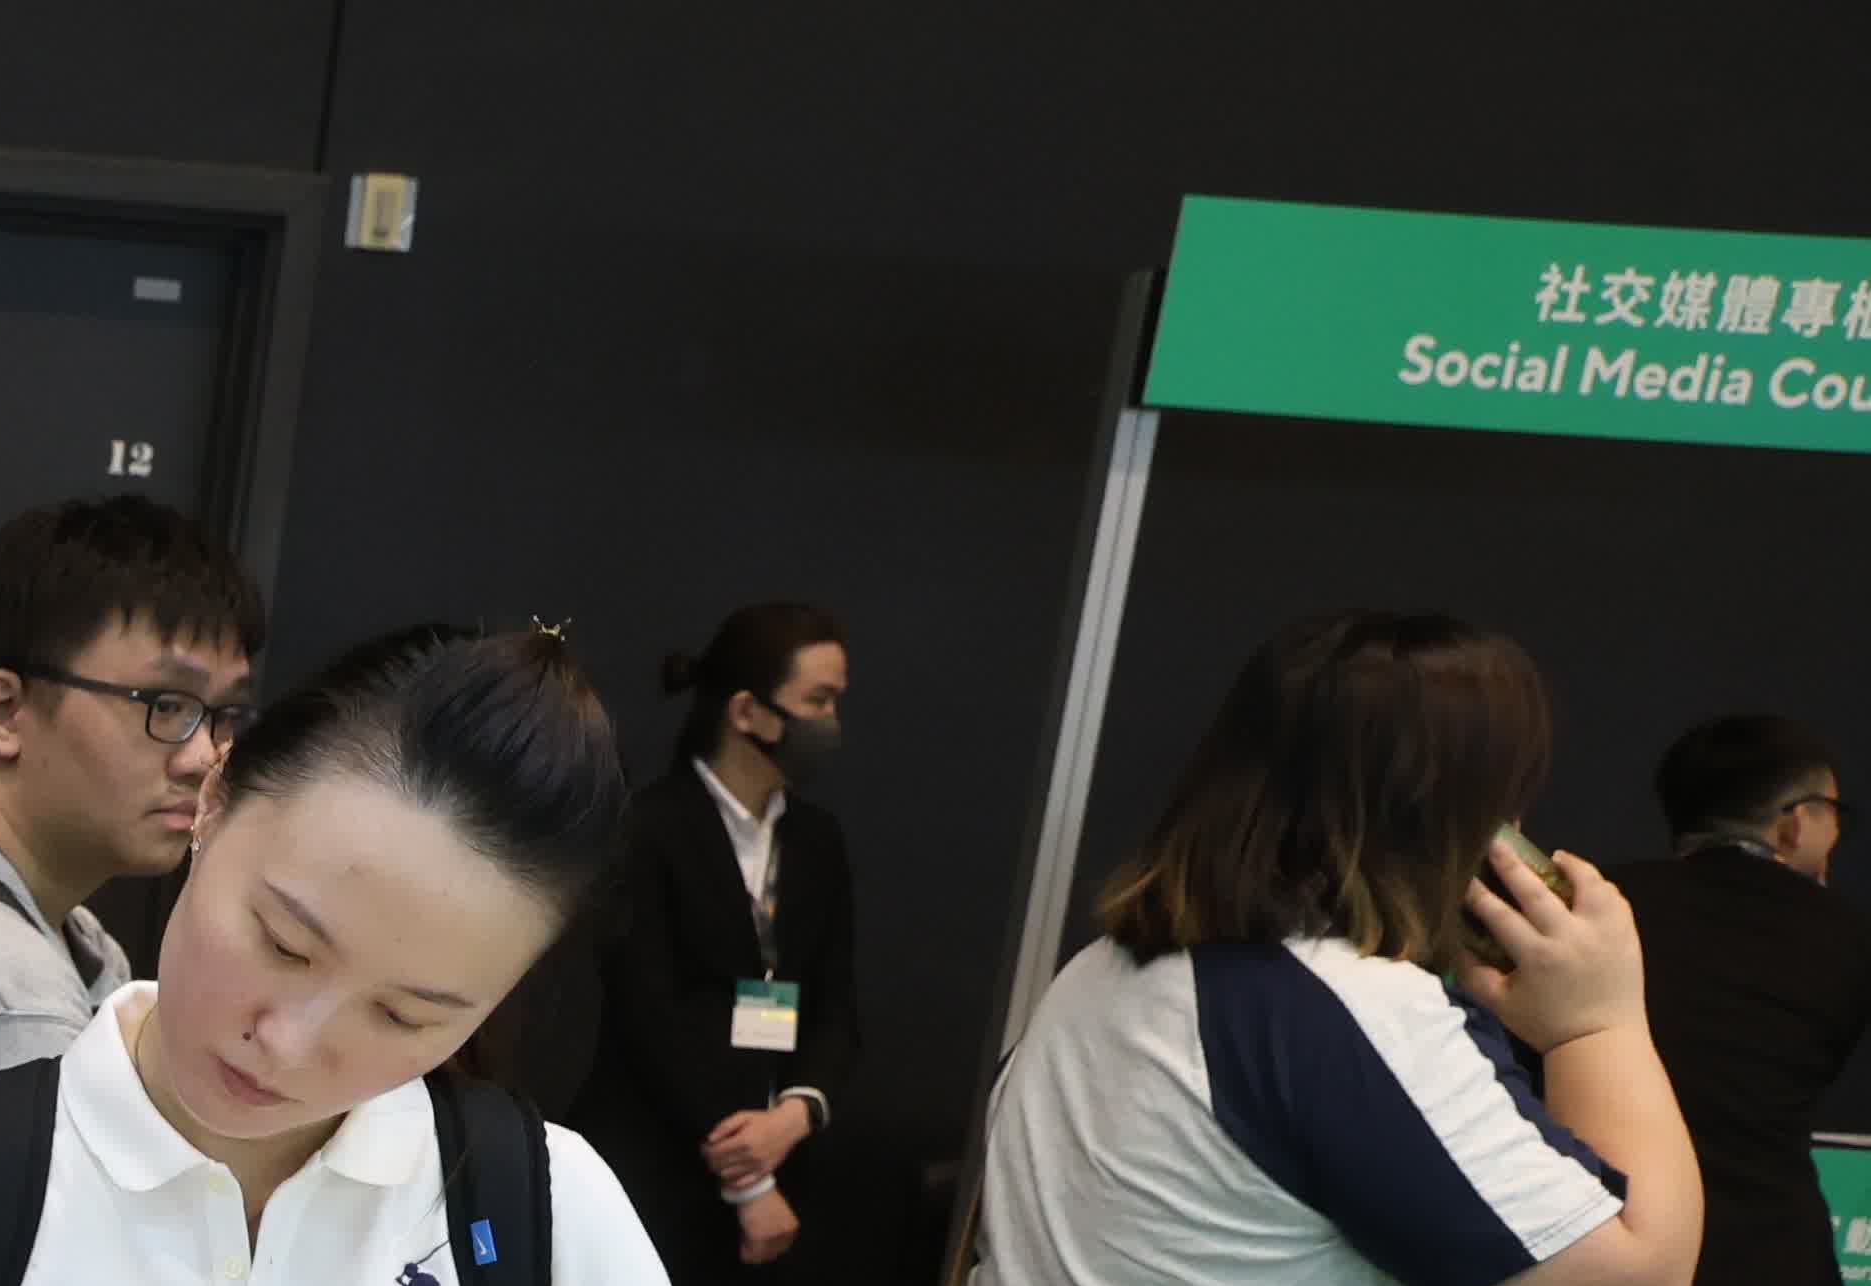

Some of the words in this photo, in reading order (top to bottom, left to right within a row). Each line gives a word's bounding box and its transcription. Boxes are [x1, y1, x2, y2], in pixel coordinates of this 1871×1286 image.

[1398, 333, 1570, 395] Social
[1579, 345, 1753, 406] Media
[1768, 356, 1871, 412] Cou
[106, 439, 154, 477] 12
